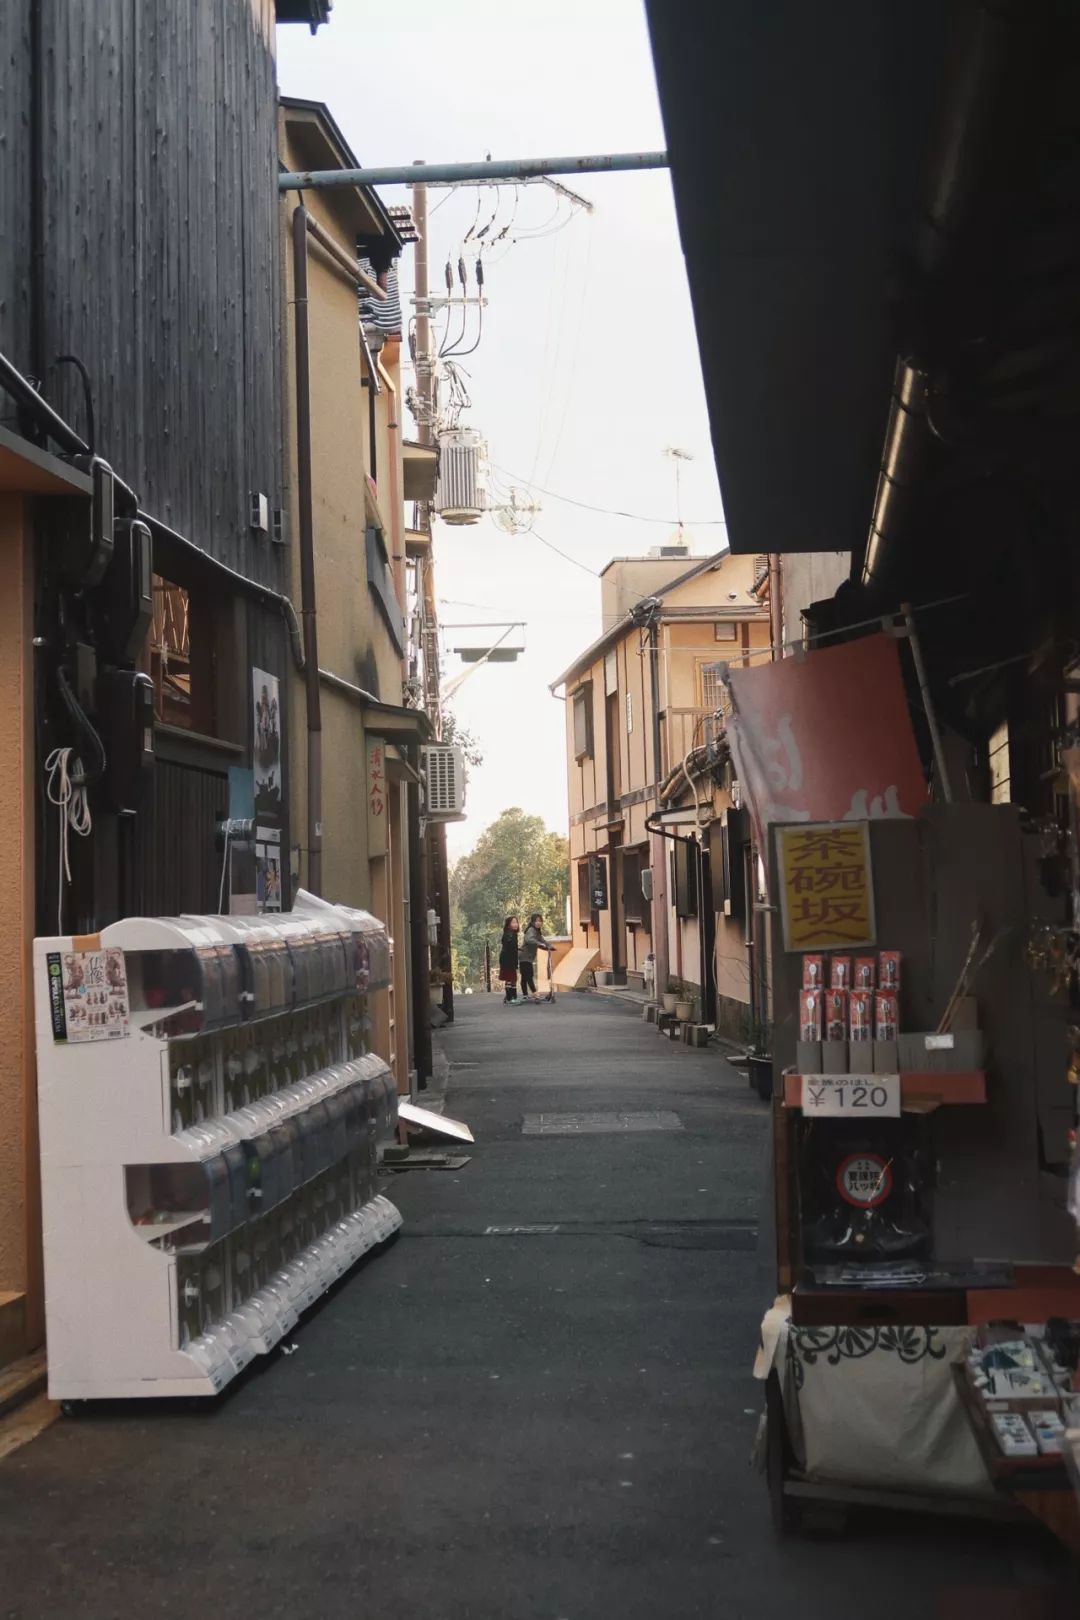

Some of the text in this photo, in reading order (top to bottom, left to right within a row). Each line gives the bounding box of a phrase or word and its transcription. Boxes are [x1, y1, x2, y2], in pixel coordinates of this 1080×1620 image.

[787, 828, 868, 943] 茶碗坂へ
[808, 1087, 888, 1107] ¥120
